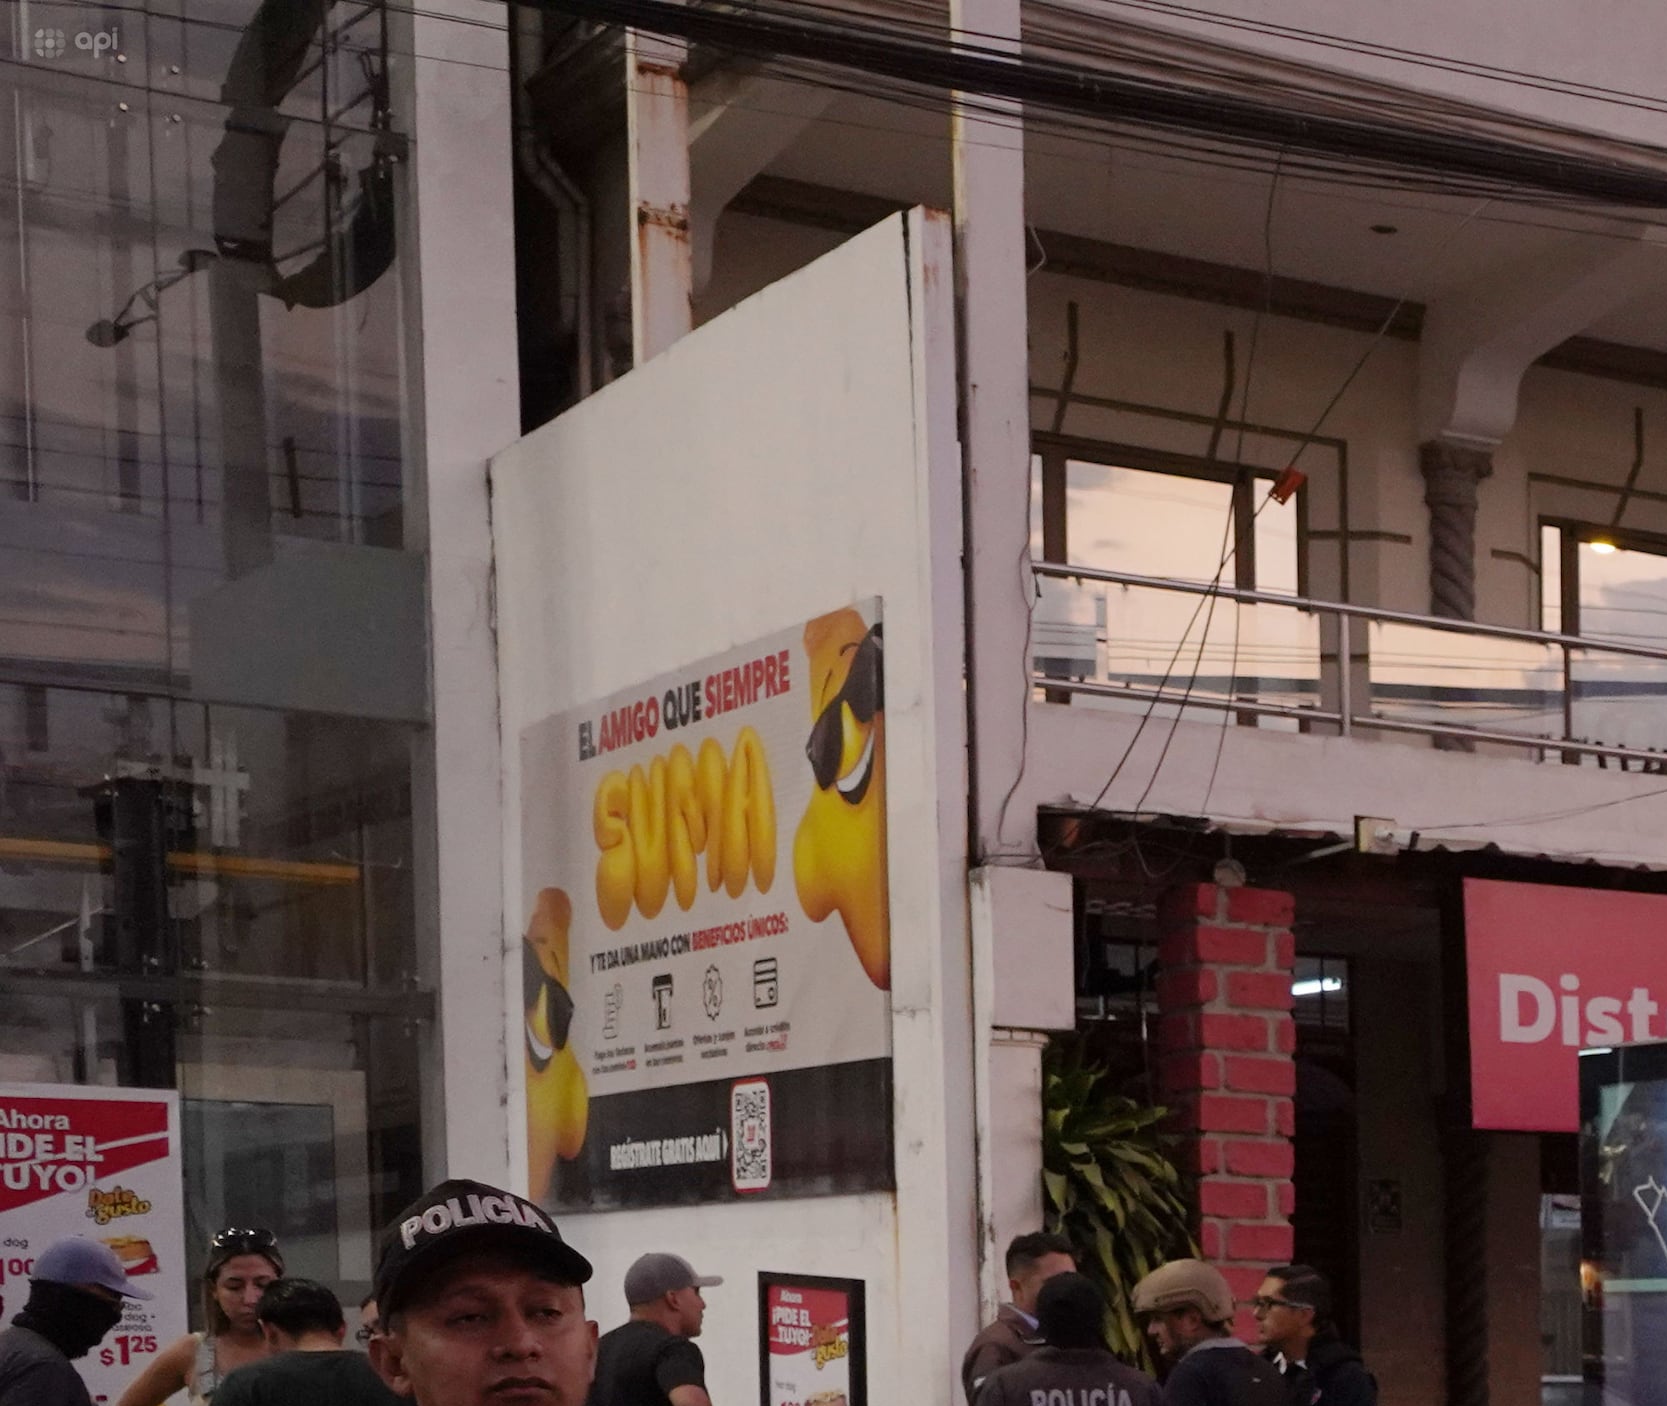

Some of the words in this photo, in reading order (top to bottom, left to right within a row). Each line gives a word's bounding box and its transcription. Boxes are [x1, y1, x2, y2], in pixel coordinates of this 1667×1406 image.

[578, 720, 597, 762] EL
[598, 696, 660, 755] AMIGO
[662, 680, 702, 731] QUE
[705, 649, 791, 719] SIEMPRE
[593, 724, 778, 931] SUMA
[0, 1162, 95, 1192] UYO!
[400, 1194, 553, 1251] POLICIA
